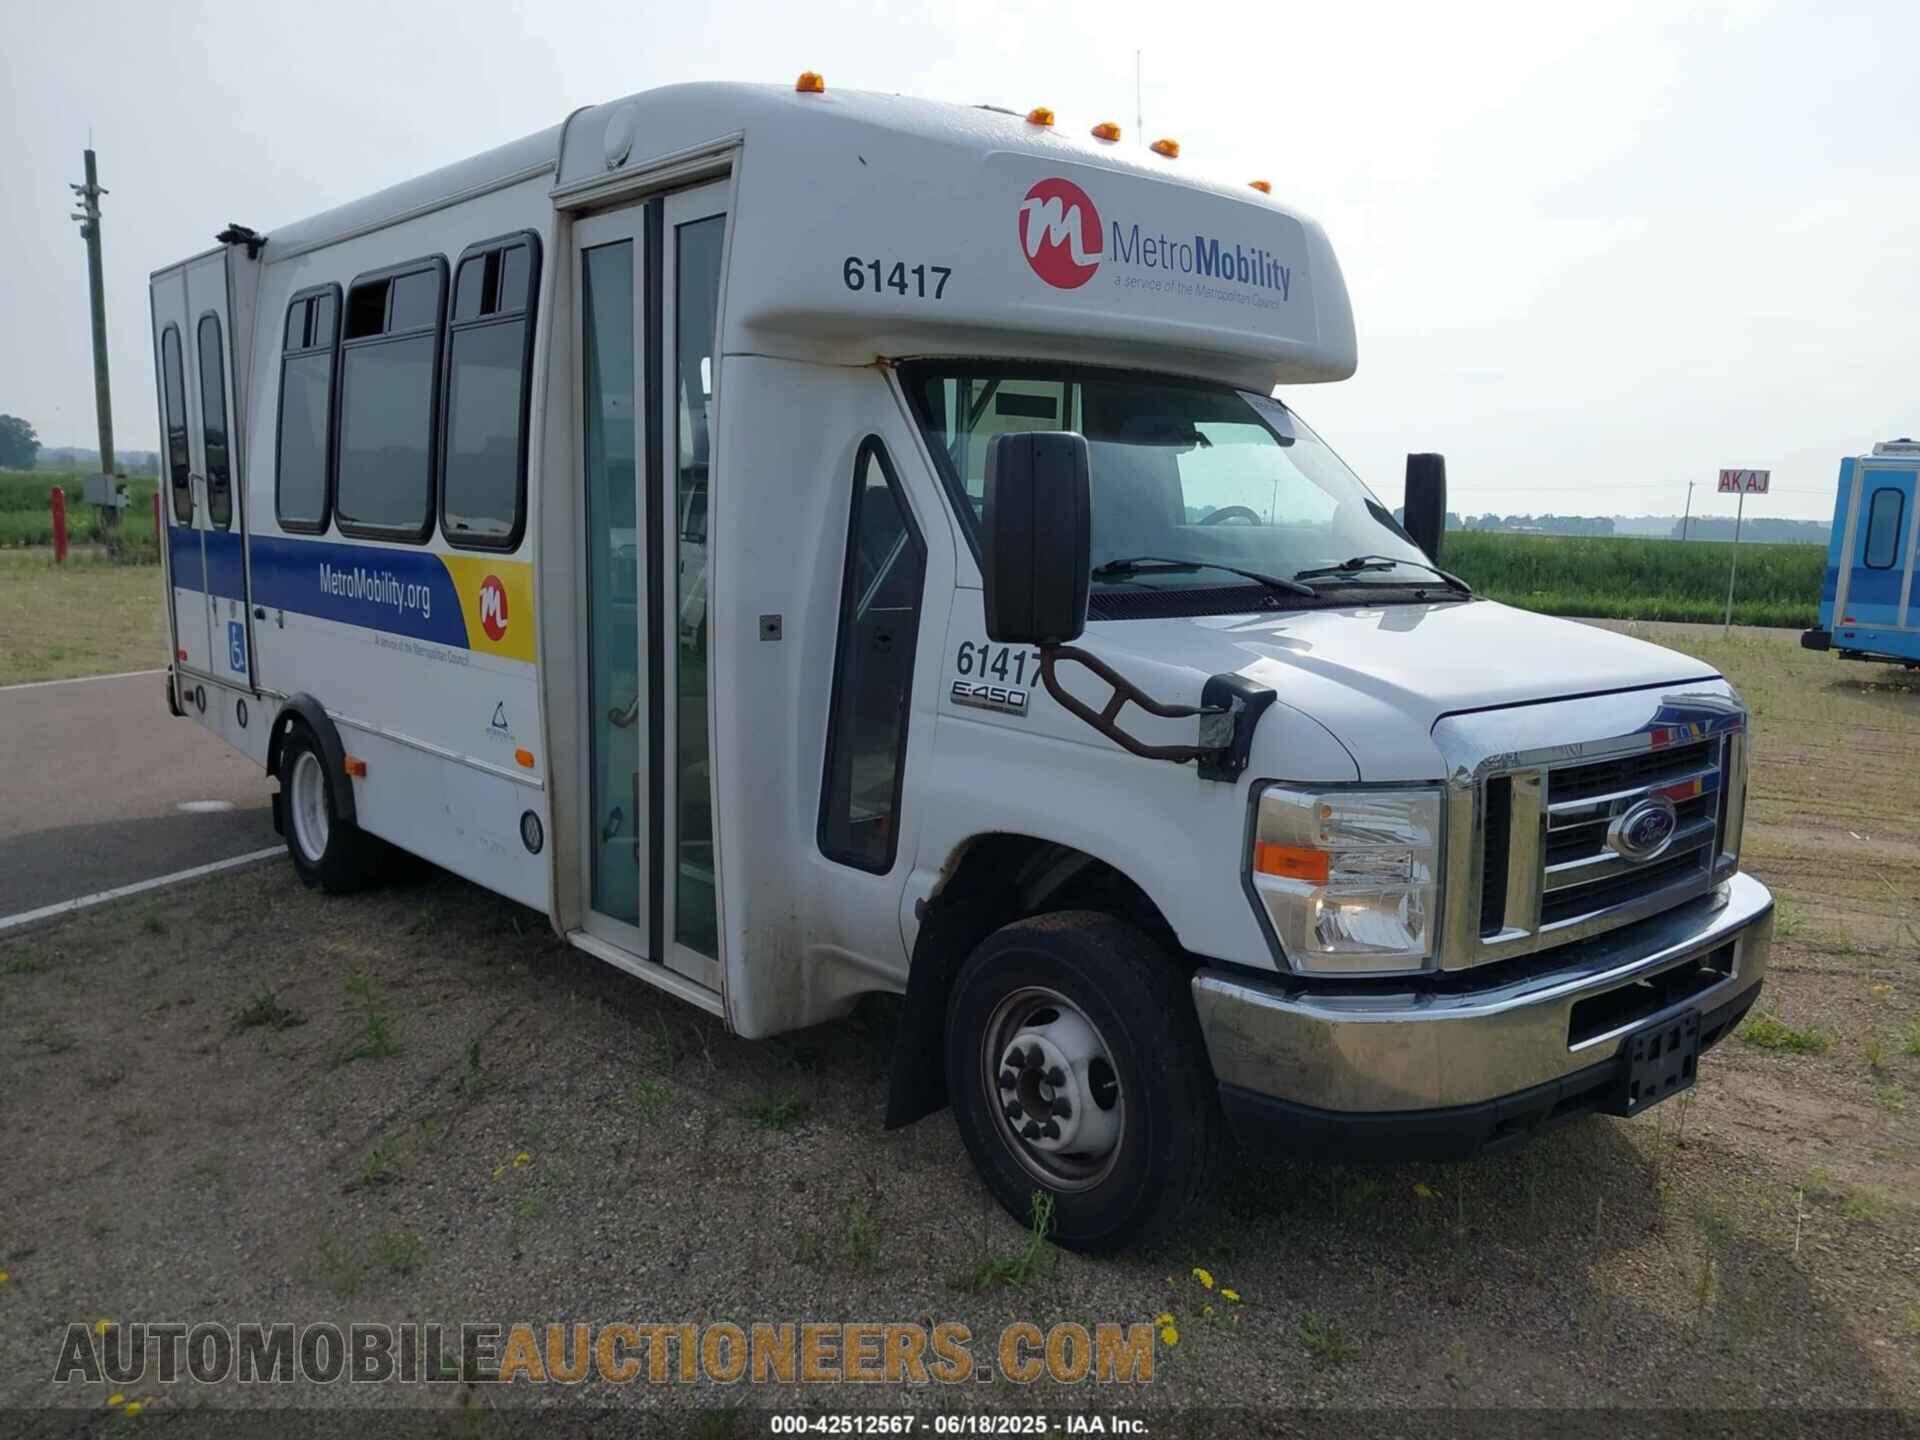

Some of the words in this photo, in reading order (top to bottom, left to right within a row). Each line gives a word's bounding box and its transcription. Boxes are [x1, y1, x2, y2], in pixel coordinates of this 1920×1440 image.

[843, 256, 952, 300] 61417
[1111, 220, 1291, 302] MetroMobility
[1720, 471, 1742, 491] AK
[1745, 471, 1768, 492] AJ
[319, 562, 431, 619] MetroMobility.org
[956, 640, 1042, 688] 61417
